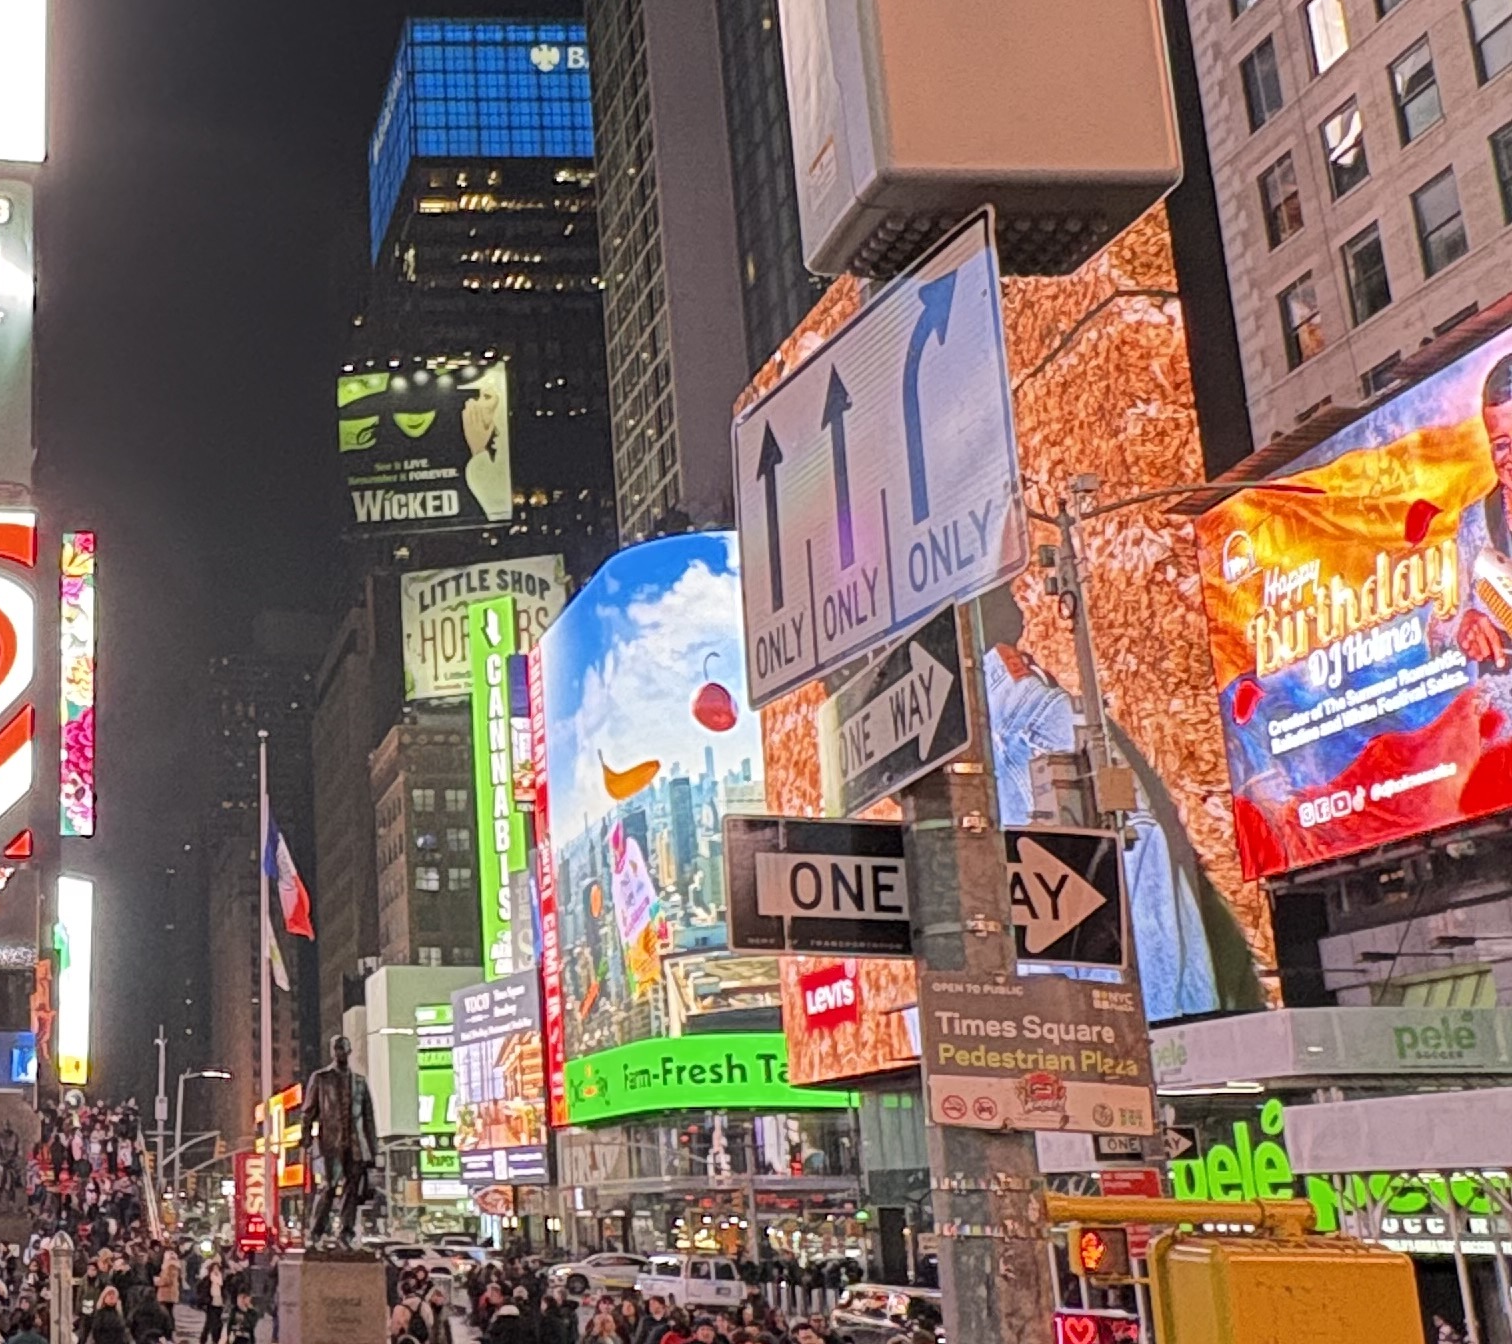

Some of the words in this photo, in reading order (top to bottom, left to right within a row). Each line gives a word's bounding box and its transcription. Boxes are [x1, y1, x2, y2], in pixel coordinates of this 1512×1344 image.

[907, 499, 993, 593] ONLY
[418, 569, 490, 614] LITTLE
[496, 568, 551, 601] SHOP
[822, 566, 879, 642] ONLY
[1246, 538, 1459, 680] Birthday
[1263, 558, 1321, 606] Happy
[755, 611, 805, 679] ONLY
[1308, 641, 1341, 689] DJ
[1341, 615, 1423, 673] Holmes
[890, 666, 935, 742] WAY
[486, 654, 512, 922] CANNABIS
[789, 861, 904, 915] ONE
[1010, 872, 1070, 922] AY
[931, 982, 964, 994] OPEN
[966, 983, 981, 995] TO
[982, 984, 1024, 996] PUBLIC
[934, 1010, 1018, 1039] Times
[1022, 1014, 1116, 1046] Square
[937, 1042, 1077, 1072] Pedestrian
[1080, 1049, 1139, 1077] Plaza
[1107, 1137, 1139, 1153] ONE
